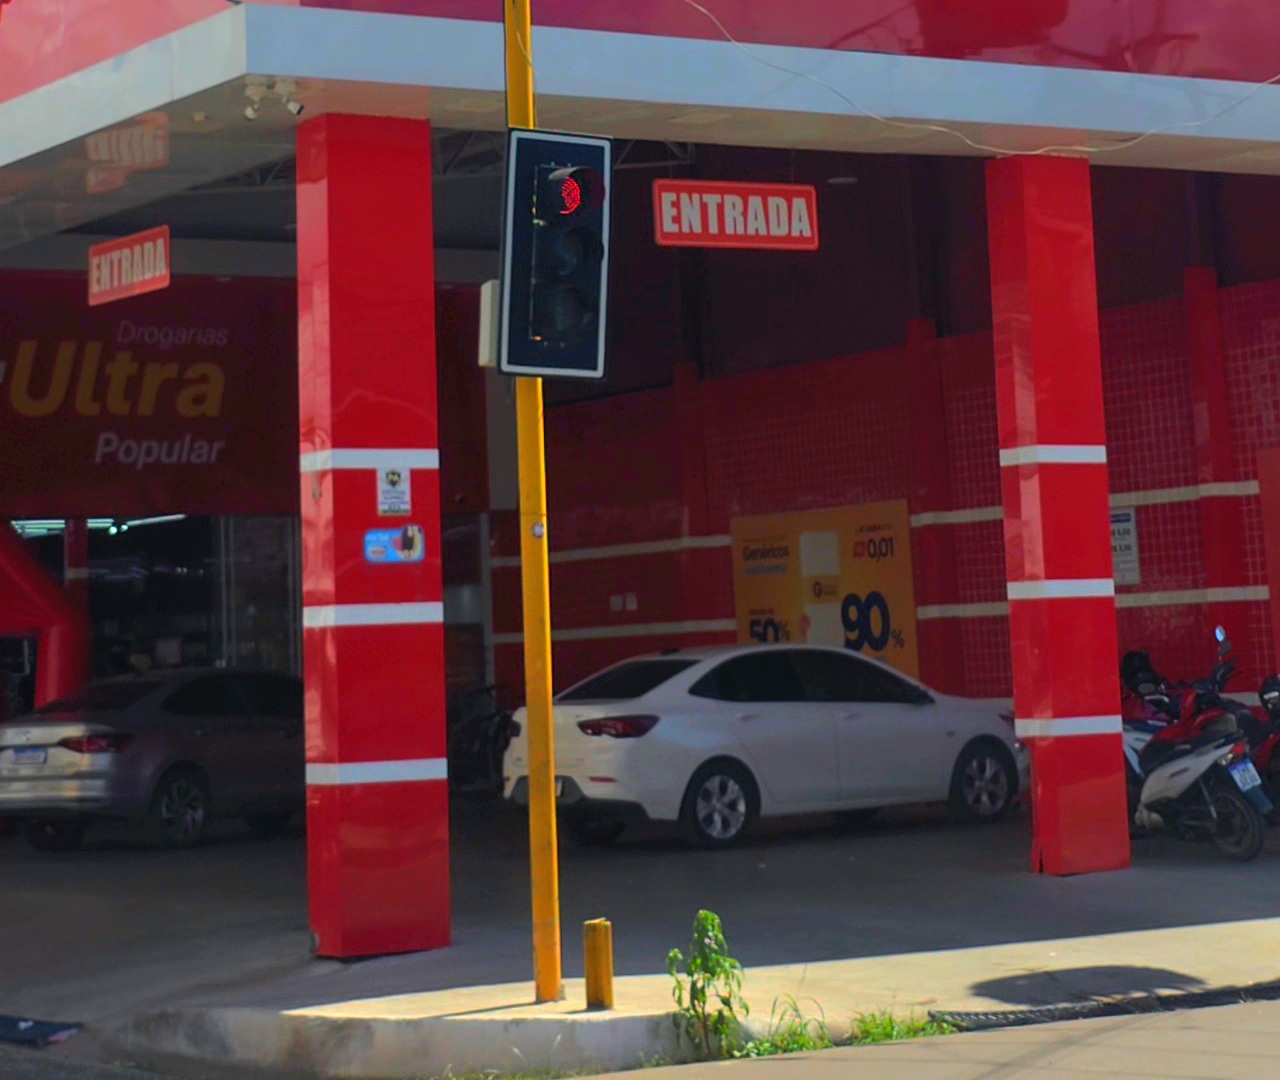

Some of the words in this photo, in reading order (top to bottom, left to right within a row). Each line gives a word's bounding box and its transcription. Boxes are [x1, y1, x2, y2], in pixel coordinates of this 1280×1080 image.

[660, 191, 812, 238] ENTRADA
[90, 245, 168, 297] ENTRADA
[116, 320, 229, 350] Drogarias
[10, 339, 226, 418] Ultra
[95, 432, 226, 471] Popular
